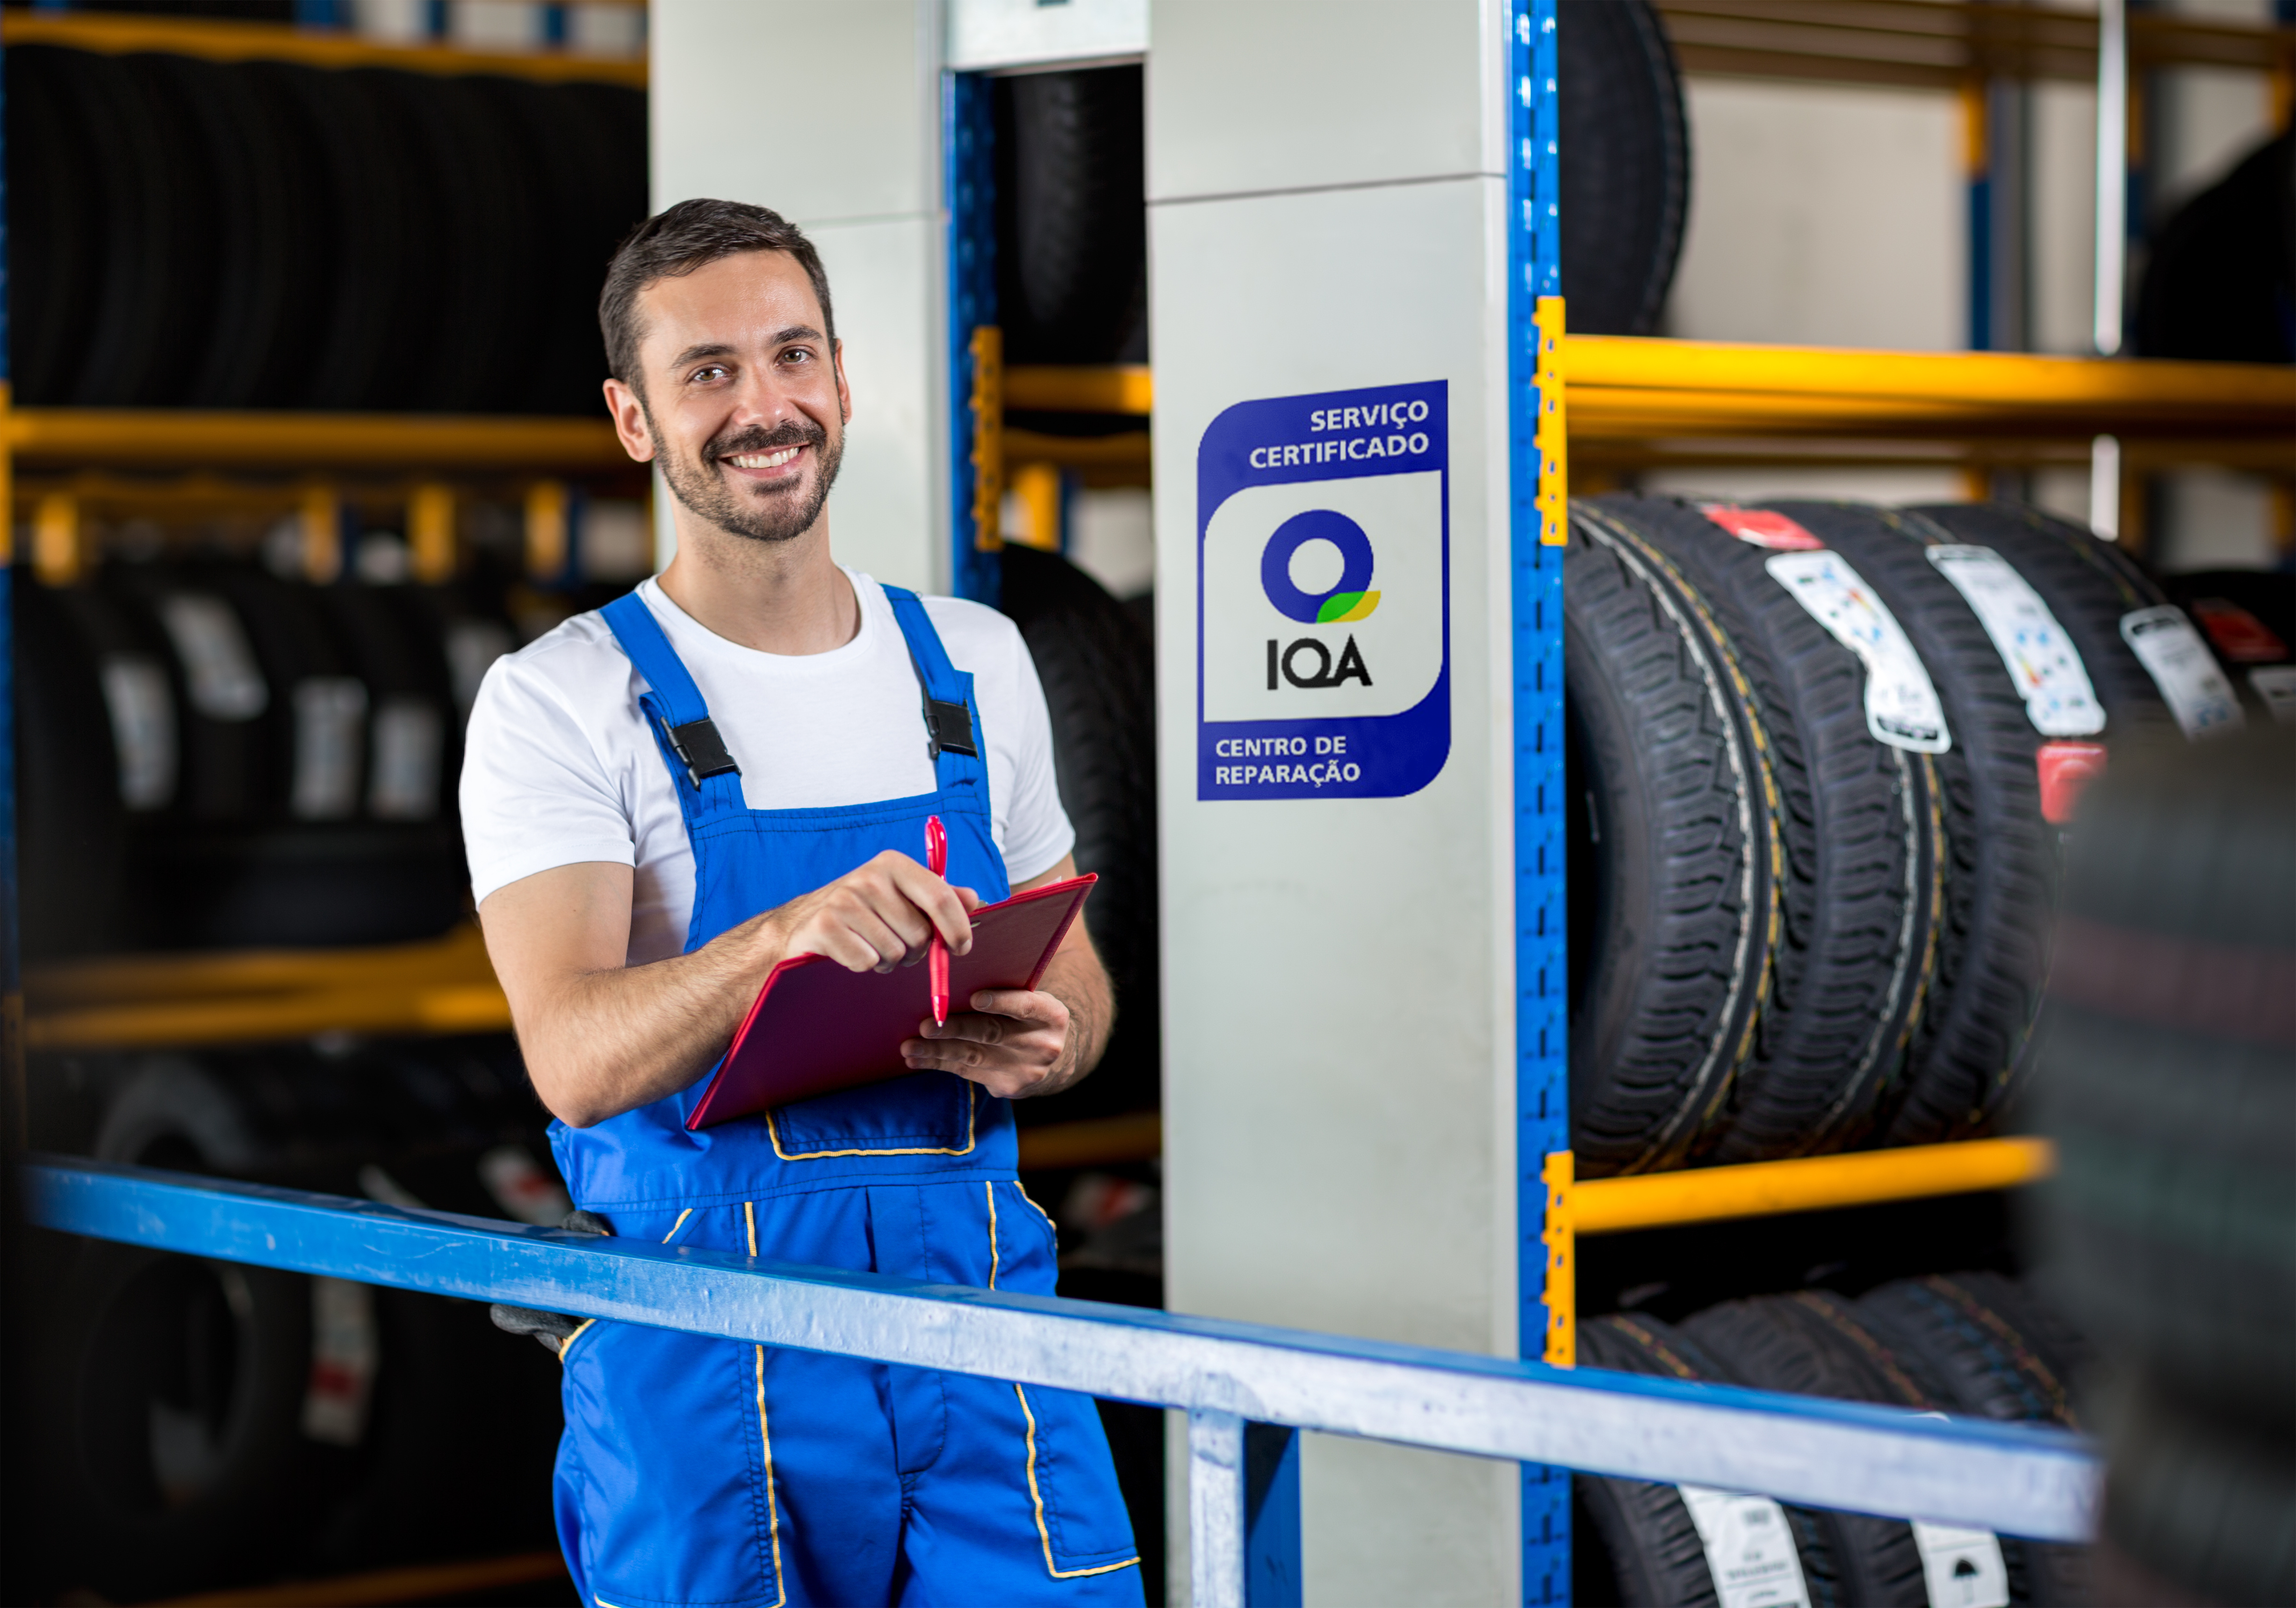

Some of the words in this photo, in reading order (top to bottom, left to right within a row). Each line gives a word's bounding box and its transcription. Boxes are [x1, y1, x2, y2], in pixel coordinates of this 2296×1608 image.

[1310, 400, 1429, 430] SERVIÇO
[1249, 432, 1429, 469] CERTIFICADO
[1267, 633, 1374, 691] IQA
[1215, 737, 1307, 758] CENTRO
[1315, 735, 1346, 755] DE
[1216, 759, 1361, 788] REPARAÇÃO
